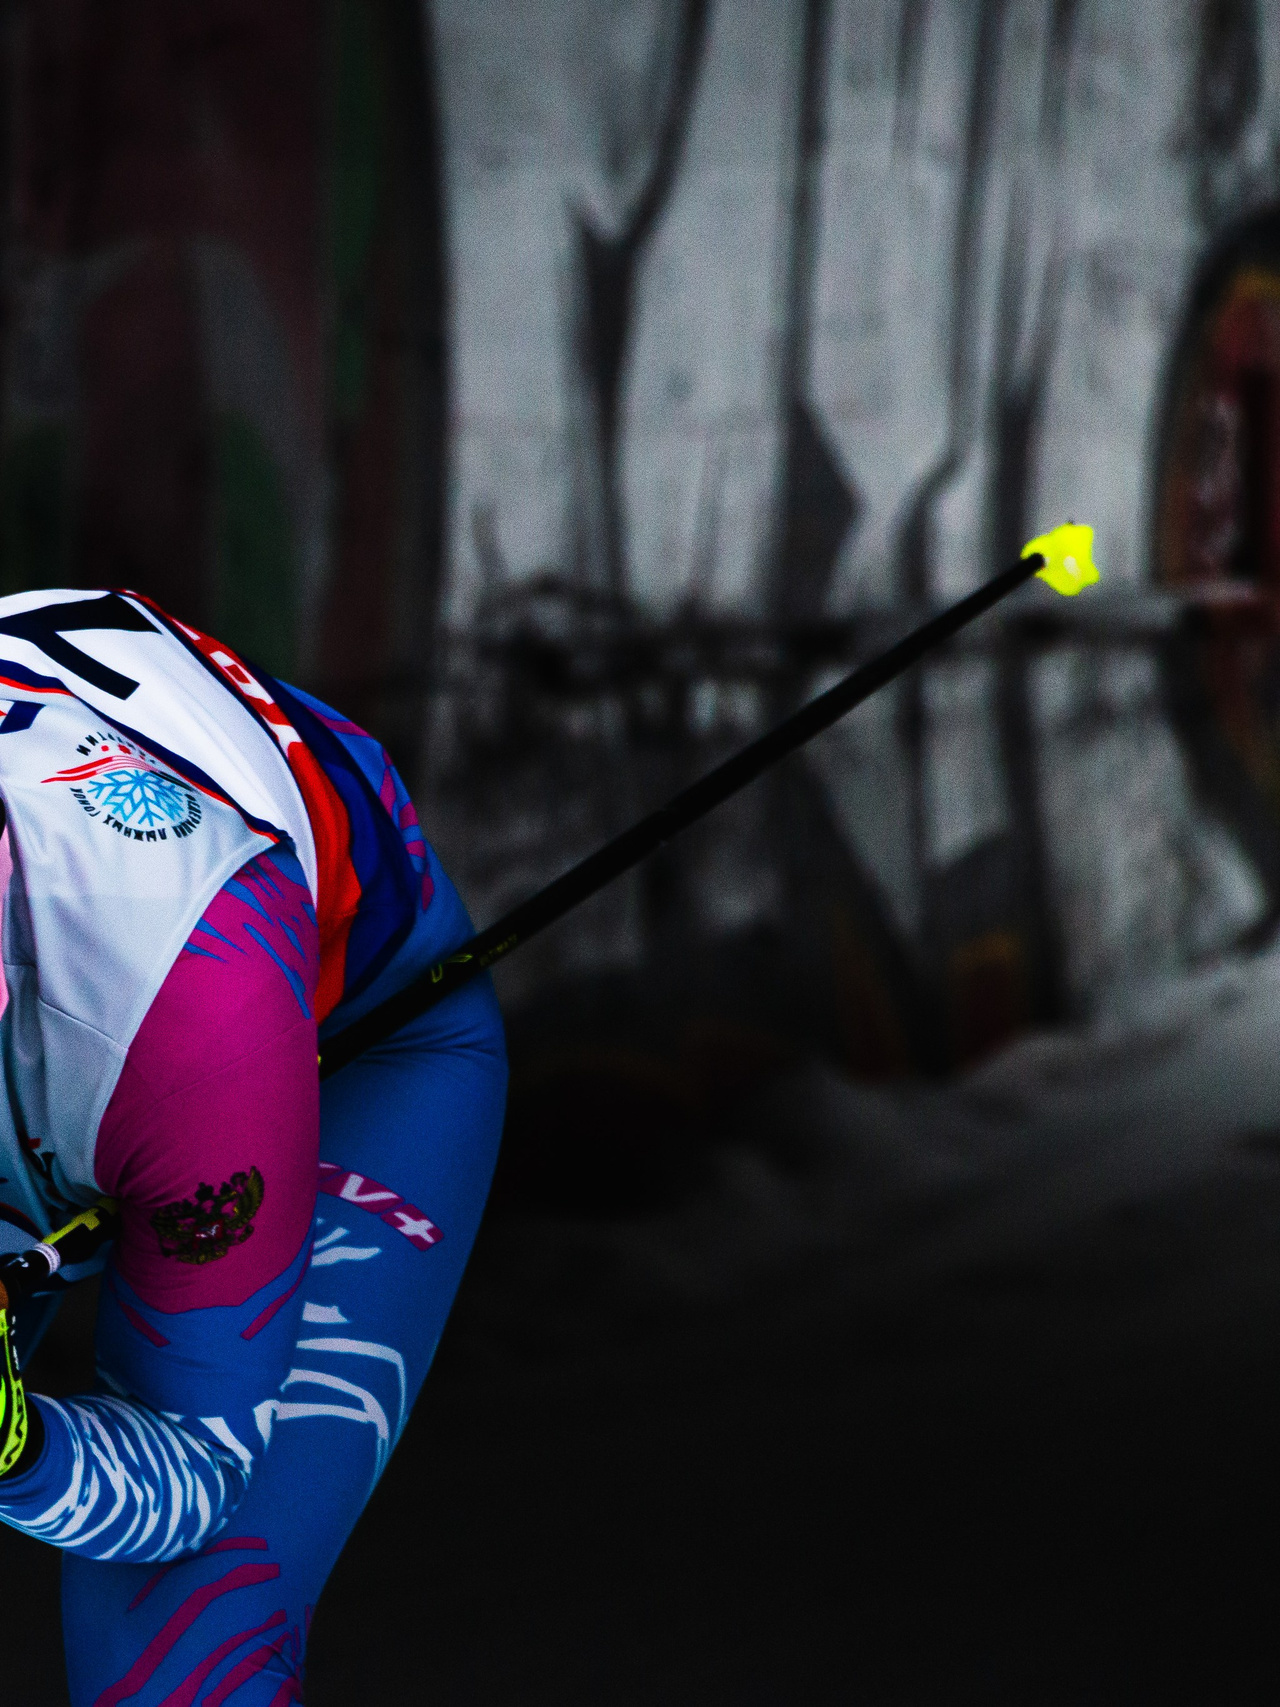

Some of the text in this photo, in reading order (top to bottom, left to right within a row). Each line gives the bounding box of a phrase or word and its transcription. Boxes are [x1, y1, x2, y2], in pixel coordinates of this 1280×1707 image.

[70, 787, 101, 818] ГОНОК
[103, 814, 167, 842] ЛЫЖНЫХ
[318, 1161, 444, 1251] V+
